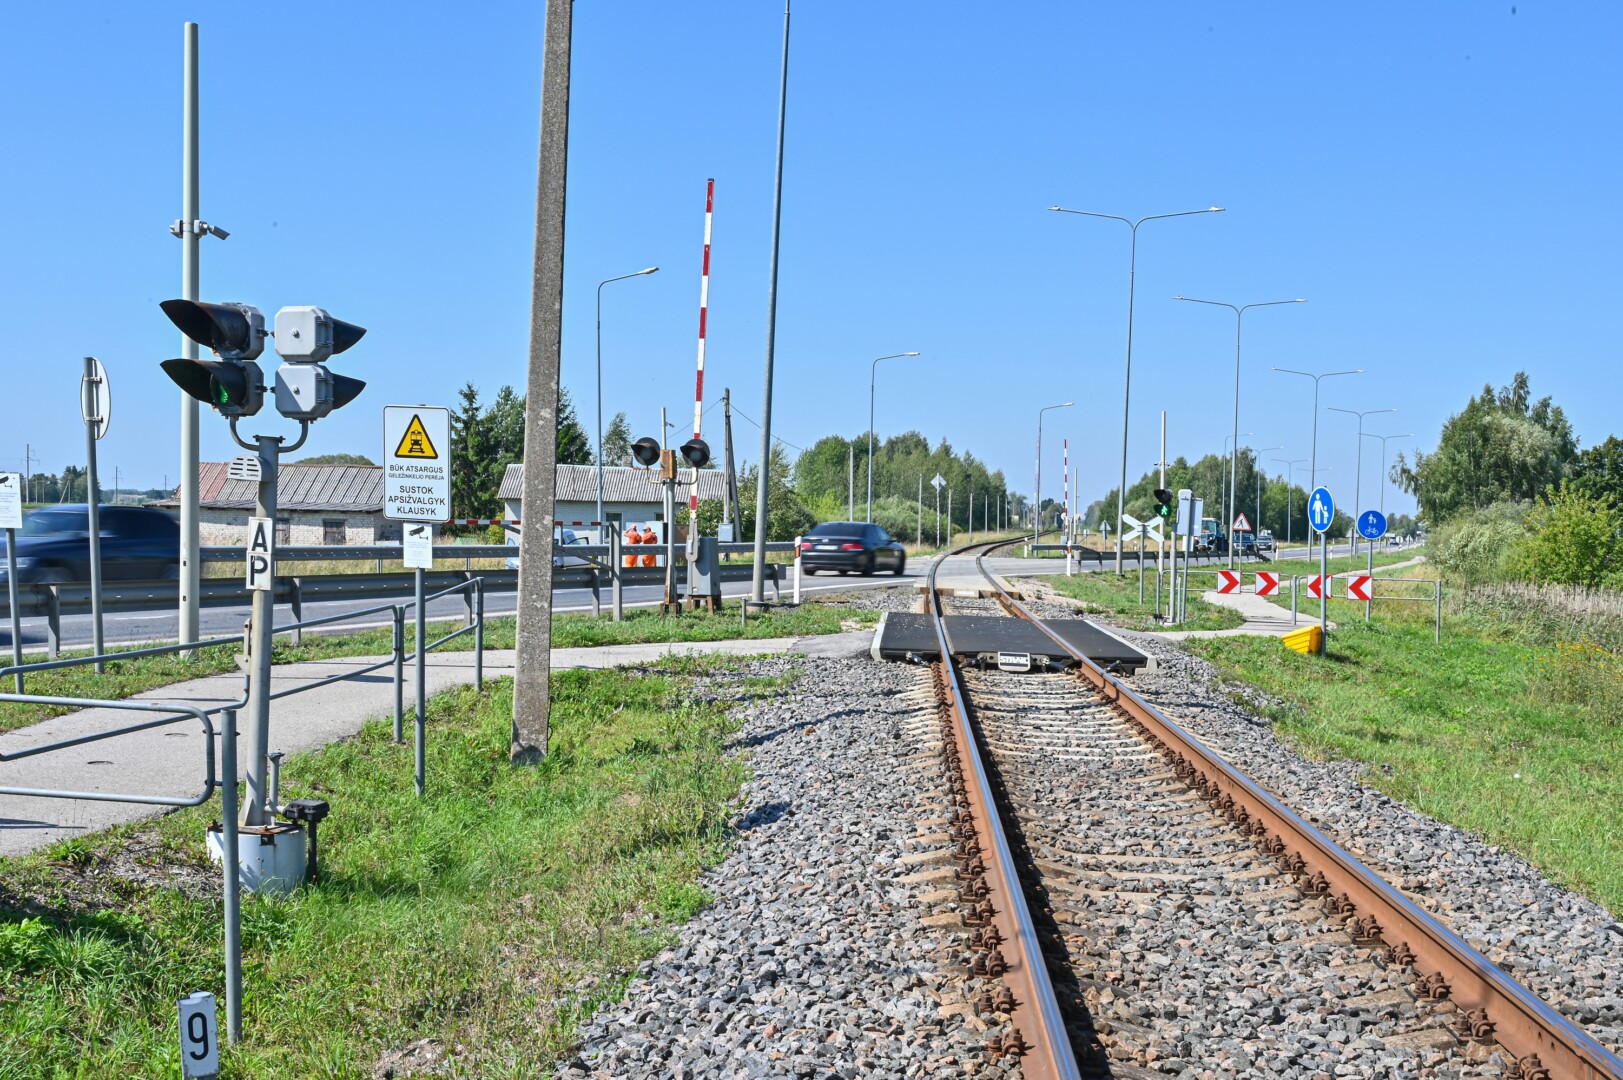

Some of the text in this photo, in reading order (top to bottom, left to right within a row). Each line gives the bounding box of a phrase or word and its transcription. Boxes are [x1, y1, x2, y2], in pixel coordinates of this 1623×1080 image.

[388, 494, 446, 505] APSIŽVALGYK
[400, 486, 434, 494] SUSTOK
[397, 506, 436, 515] KLAUSYK
[251, 522, 268, 552] A
[250, 555, 268, 586] P
[188, 1012, 209, 1060] 9
